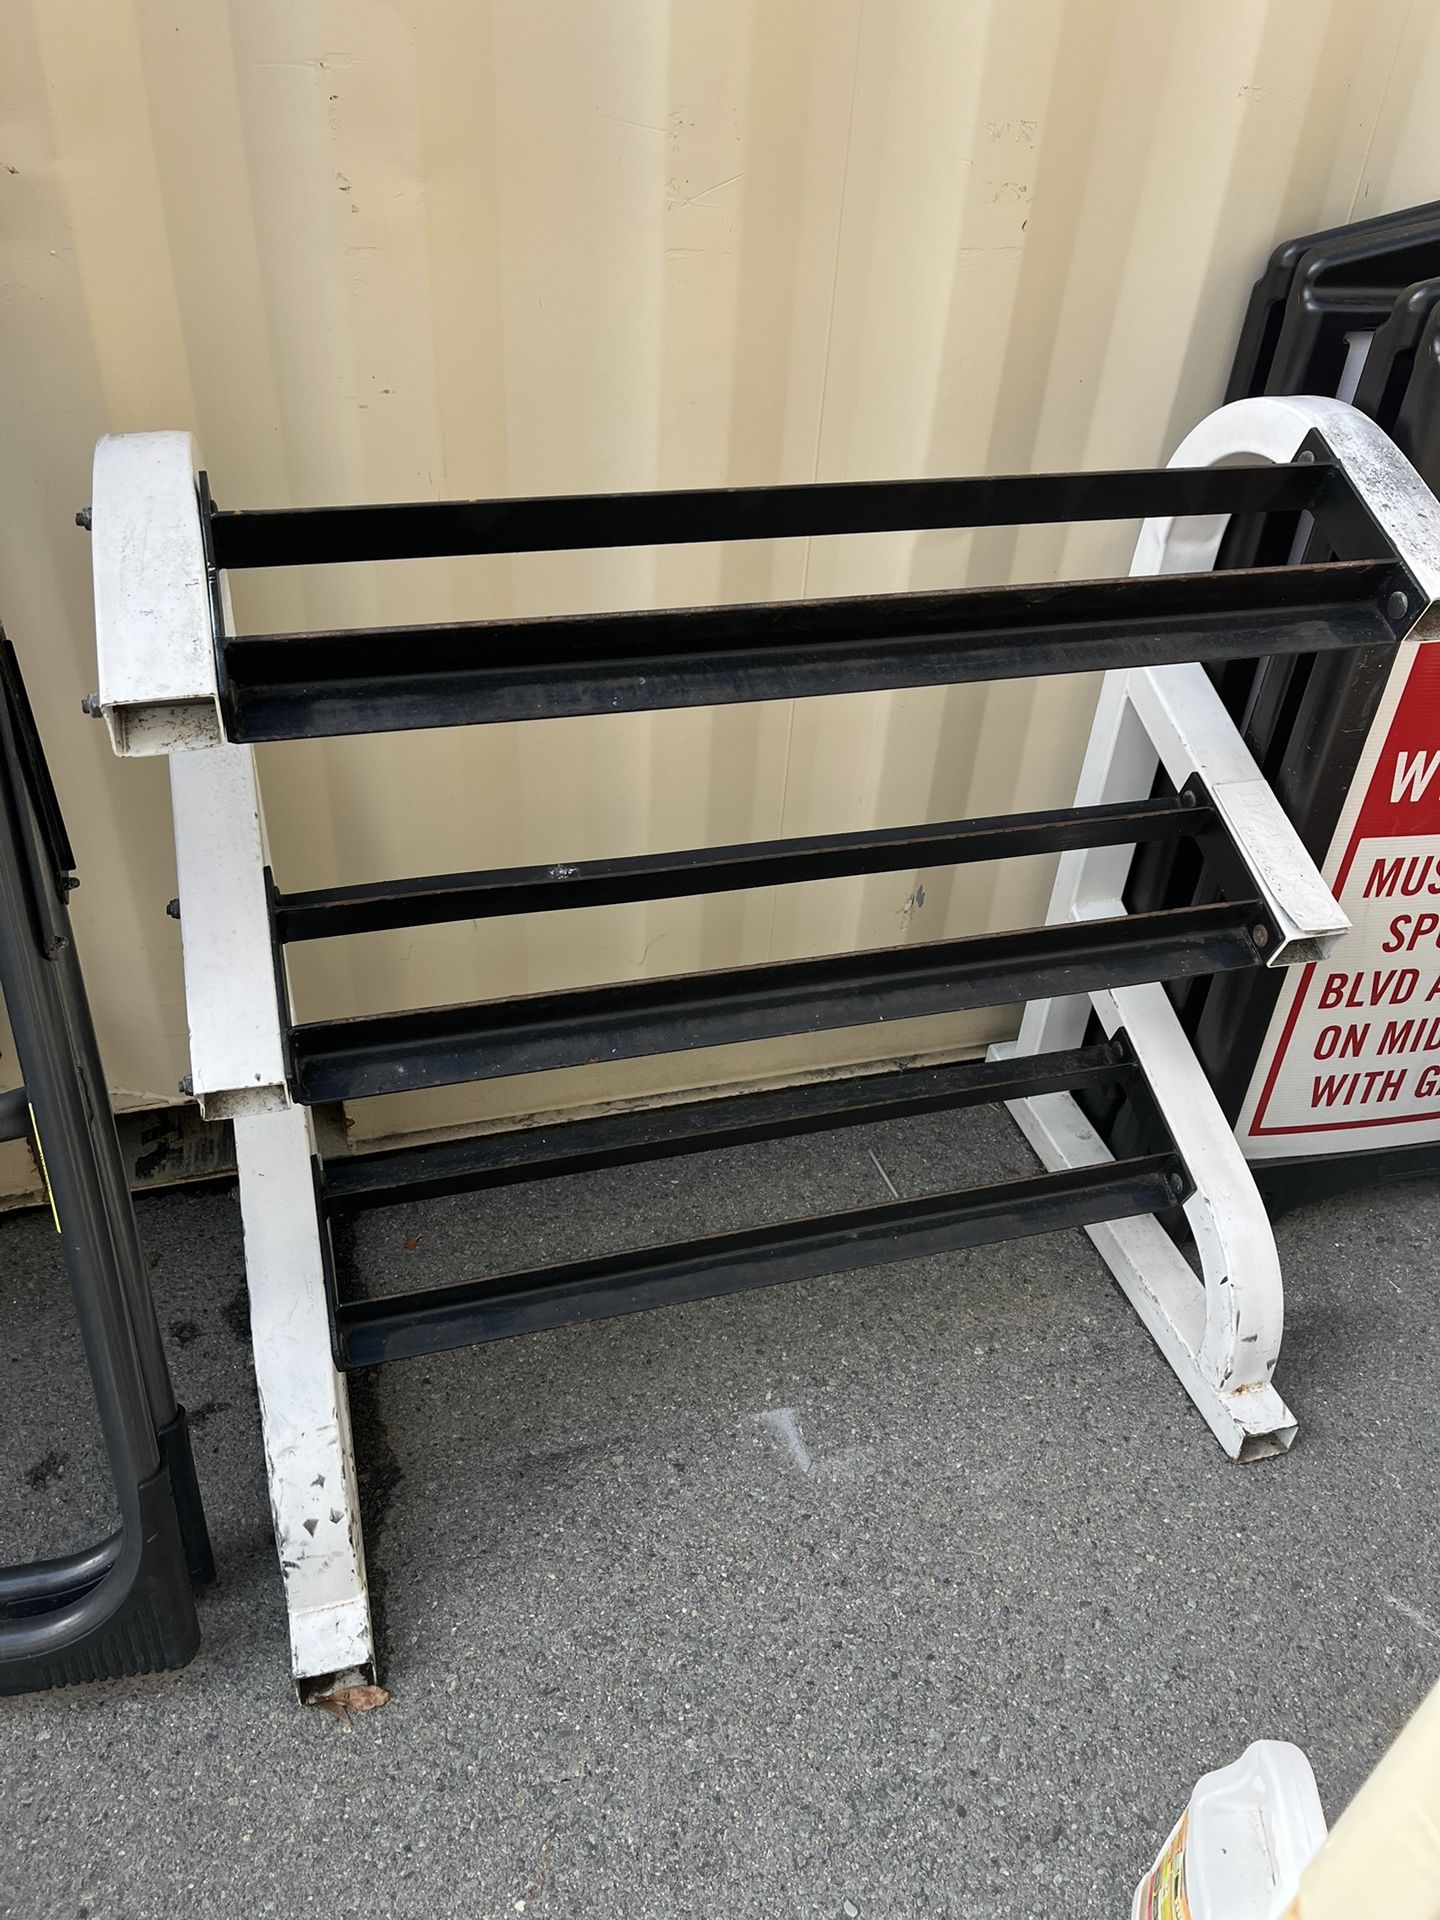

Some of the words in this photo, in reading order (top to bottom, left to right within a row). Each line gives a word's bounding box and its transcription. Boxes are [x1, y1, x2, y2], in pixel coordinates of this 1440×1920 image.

[1390, 750, 1440, 803] W
[1382, 913, 1440, 953] SP
[1318, 968, 1420, 1009] BLVD
[1313, 1023, 1371, 1060] ON
[1311, 1068, 1408, 1108] WITH
[1414, 1065, 1440, 1098] G
